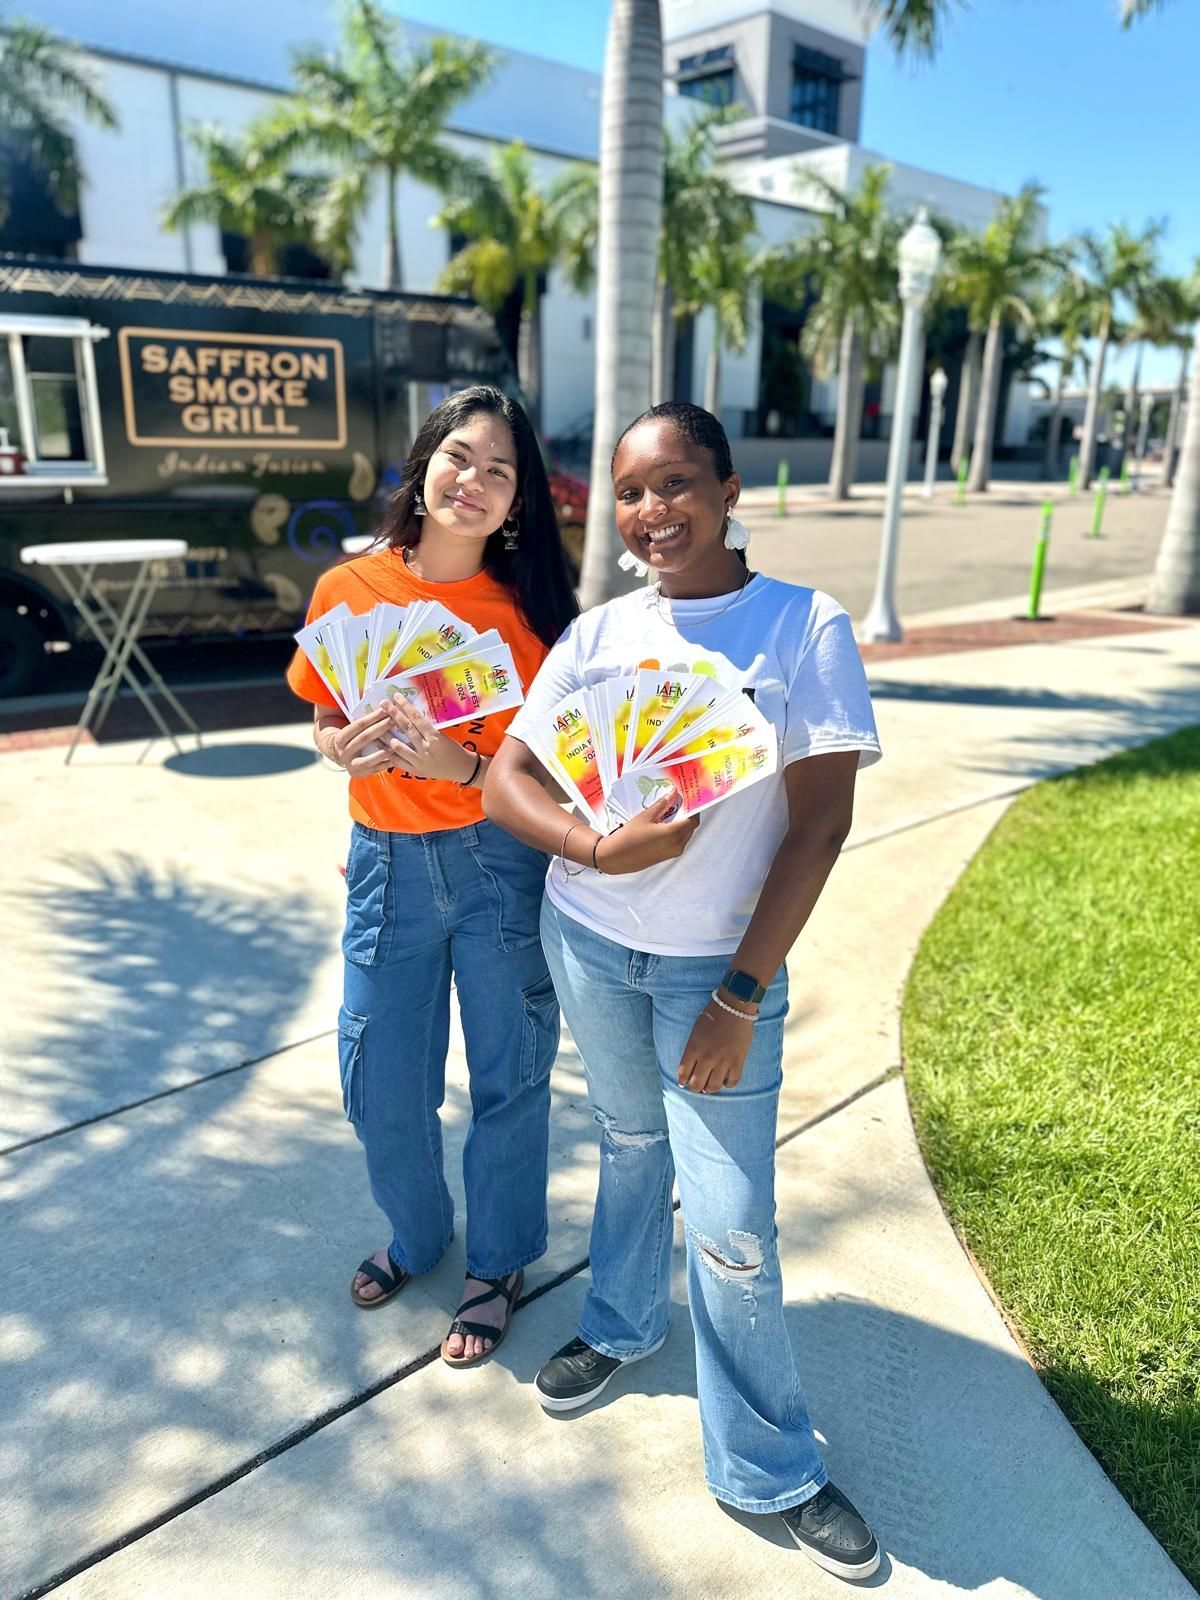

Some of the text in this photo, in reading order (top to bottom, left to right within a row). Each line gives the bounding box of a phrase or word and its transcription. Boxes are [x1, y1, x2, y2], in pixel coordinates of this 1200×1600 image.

[141, 344, 328, 381] SAFFRON
[168, 375, 308, 407] SMOKE
[181, 405, 299, 434] GRILL
[158, 451, 325, 478] Indian Fusion
[416, 646, 432, 660] INDI
[464, 668, 475, 690] INDIA
[470, 690, 480, 708] FEST
[493, 664, 508, 694] IAFM
[456, 682, 466, 701] 2024
[552, 708, 582, 732] IAFM
[646, 719, 662, 727] IND
[566, 743, 588, 760] INDIA
[583, 750, 596, 763] 202
[724, 754, 732, 775] INDIA
